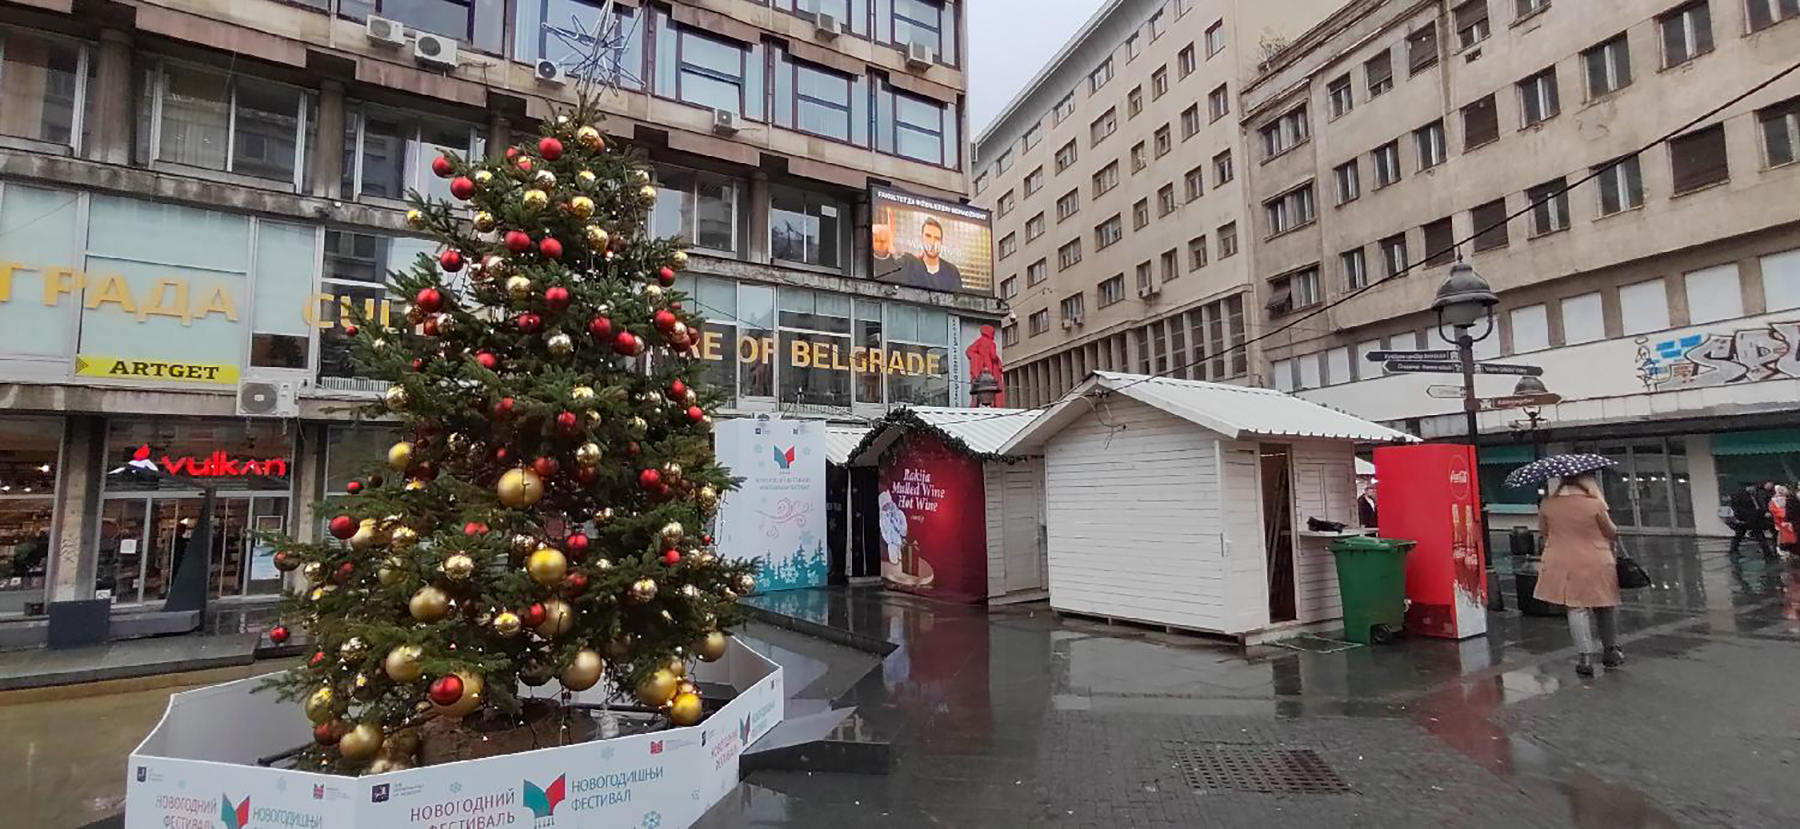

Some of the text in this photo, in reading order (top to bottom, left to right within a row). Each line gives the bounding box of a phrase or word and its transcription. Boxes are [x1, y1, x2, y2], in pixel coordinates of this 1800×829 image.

[740, 335, 774, 364] OF
[791, 340, 941, 378] BELGRADE
[109, 360, 219, 380] ARTGET
[160, 449, 286, 477] vulkan
[903, 468, 931, 485] Rakija
[922, 484, 946, 499] Wine
[898, 495, 939, 512] Hot Wine
[571, 767, 663, 793] НОВОГОДИШЊИ
[156, 795, 217, 814] НОВОГОДНИЙ
[410, 788, 515, 822] НОВОГОДНИЙ
[571, 789, 632, 811] ФЕСТИВАЛ
